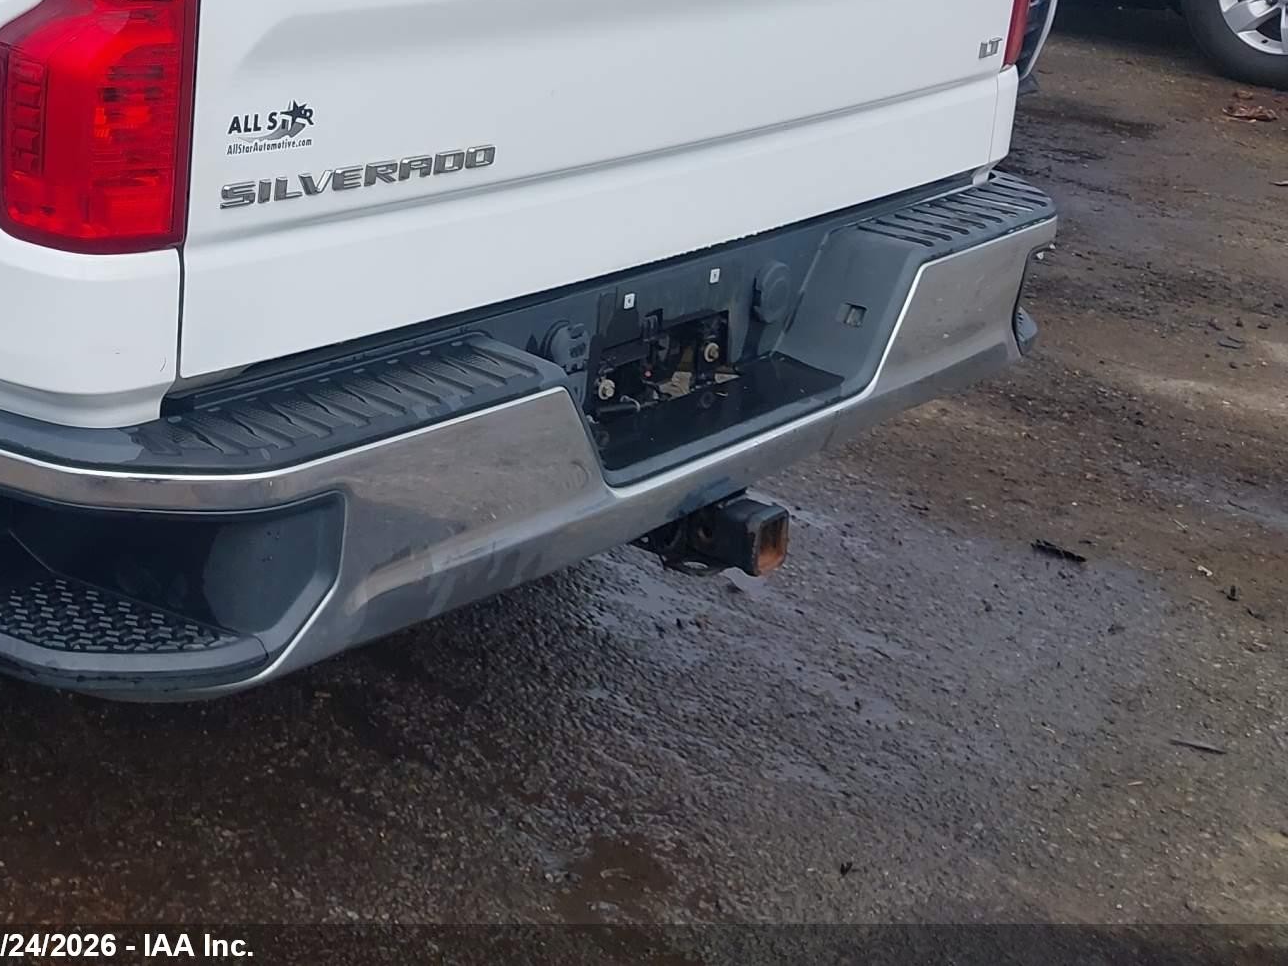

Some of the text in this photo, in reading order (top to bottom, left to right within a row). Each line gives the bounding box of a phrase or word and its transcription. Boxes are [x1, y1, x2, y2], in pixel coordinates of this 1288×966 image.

[978, 37, 1003, 59] LT
[227, 113, 262, 135] ALL
[226, 138, 313, 155] AllStarAutomotive.com
[220, 144, 496, 209] SILVERADO
